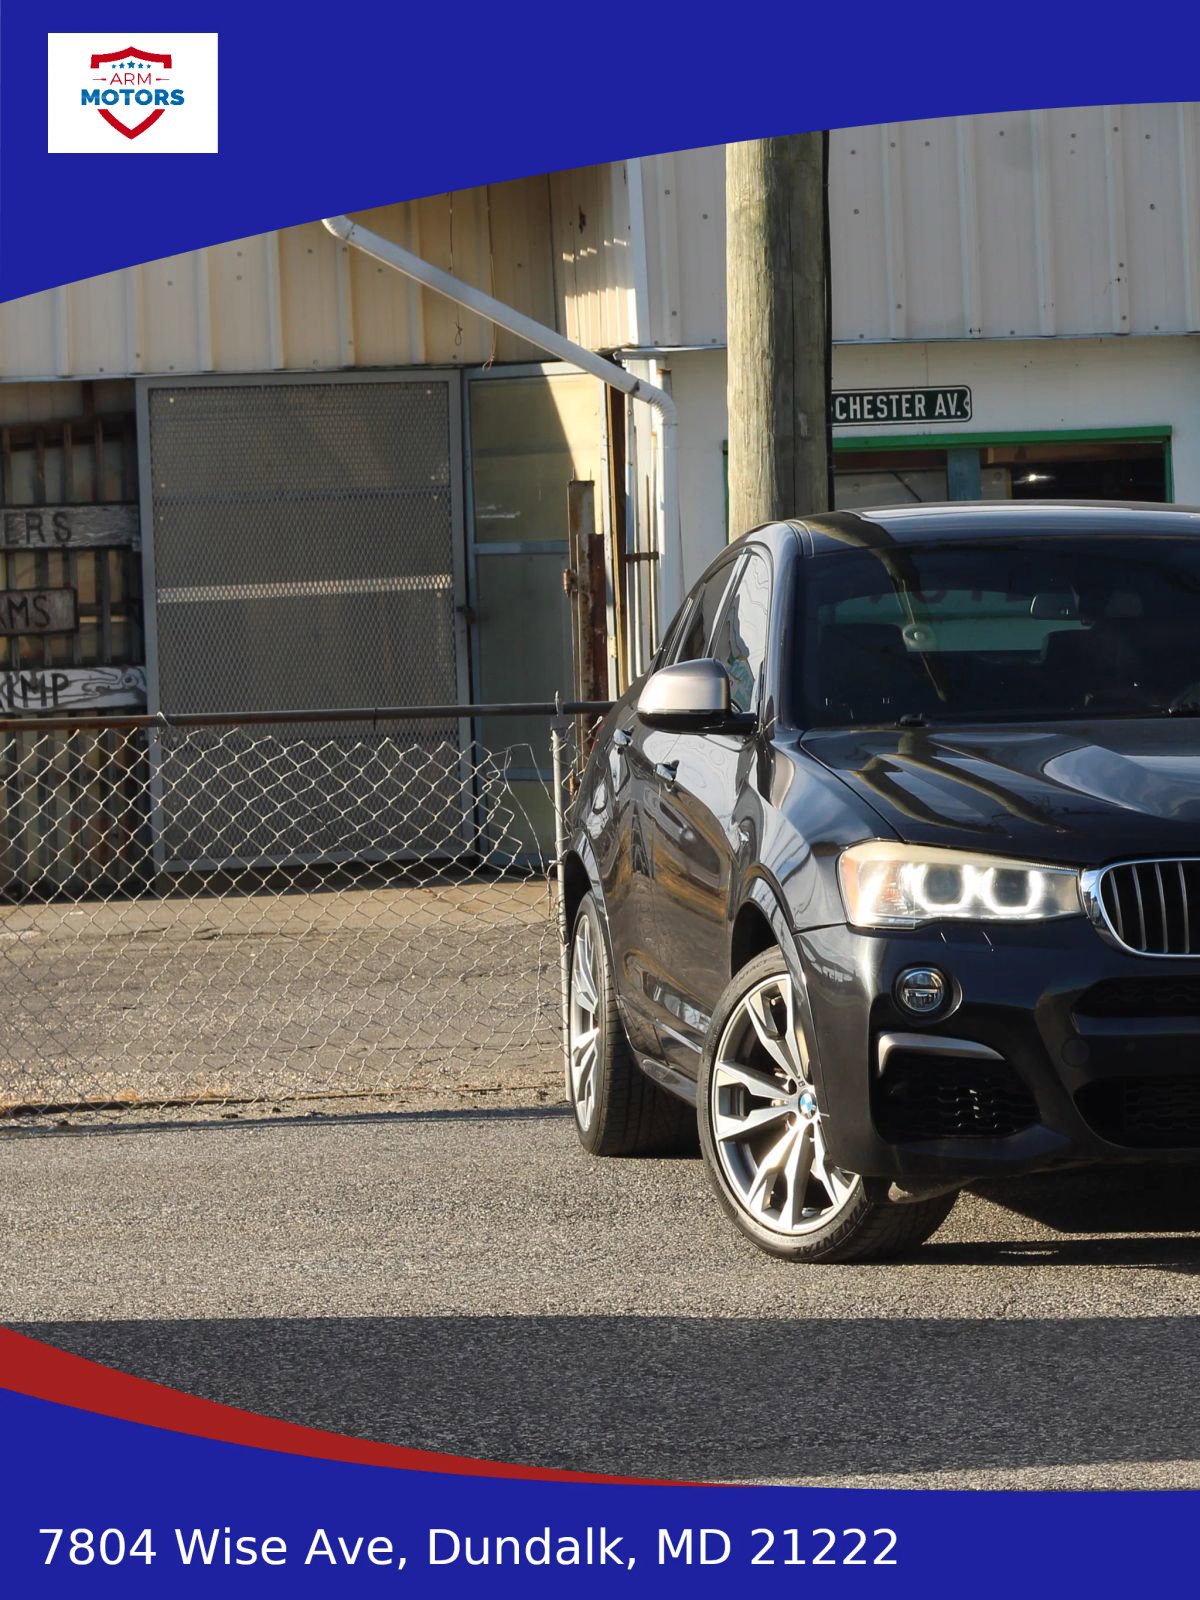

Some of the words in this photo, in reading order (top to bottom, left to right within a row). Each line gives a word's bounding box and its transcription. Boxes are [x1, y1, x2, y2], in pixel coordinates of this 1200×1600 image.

[835, 394, 927, 420] CHESTER
[934, 392, 962, 416] AV.
[0, 595, 51, 630] MS
[0, 672, 70, 711] IMP
